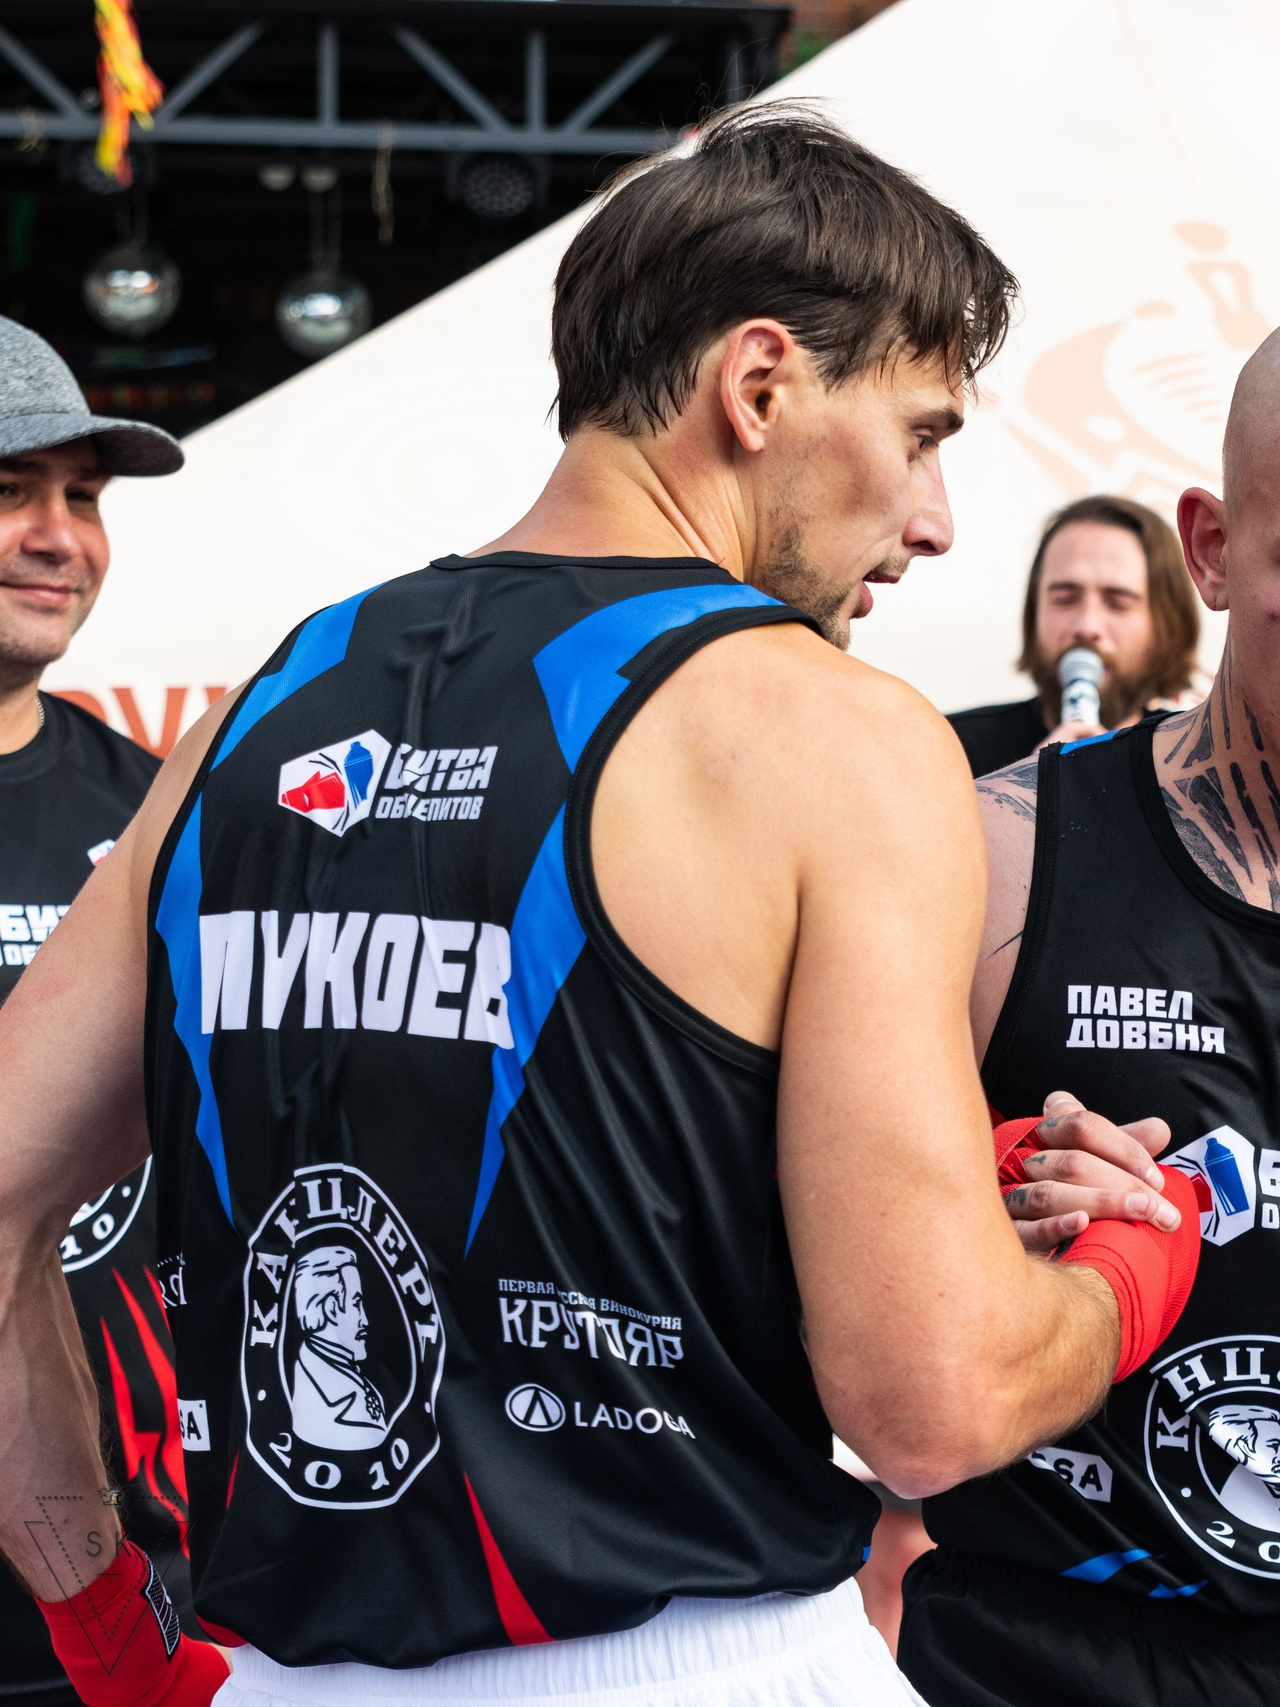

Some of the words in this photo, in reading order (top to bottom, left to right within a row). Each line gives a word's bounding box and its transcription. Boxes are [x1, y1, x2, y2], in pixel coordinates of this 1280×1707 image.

[384, 743, 499, 793] БИТВА
[1068, 984, 1193, 1020] ПАВЕЛ
[1066, 1018, 1225, 1054] ДОВБНЯ
[498, 1278, 556, 1295] ПЕРВАЯ
[573, 1402, 696, 1439] LADOGA
[268, 1432, 410, 1491] 2010
